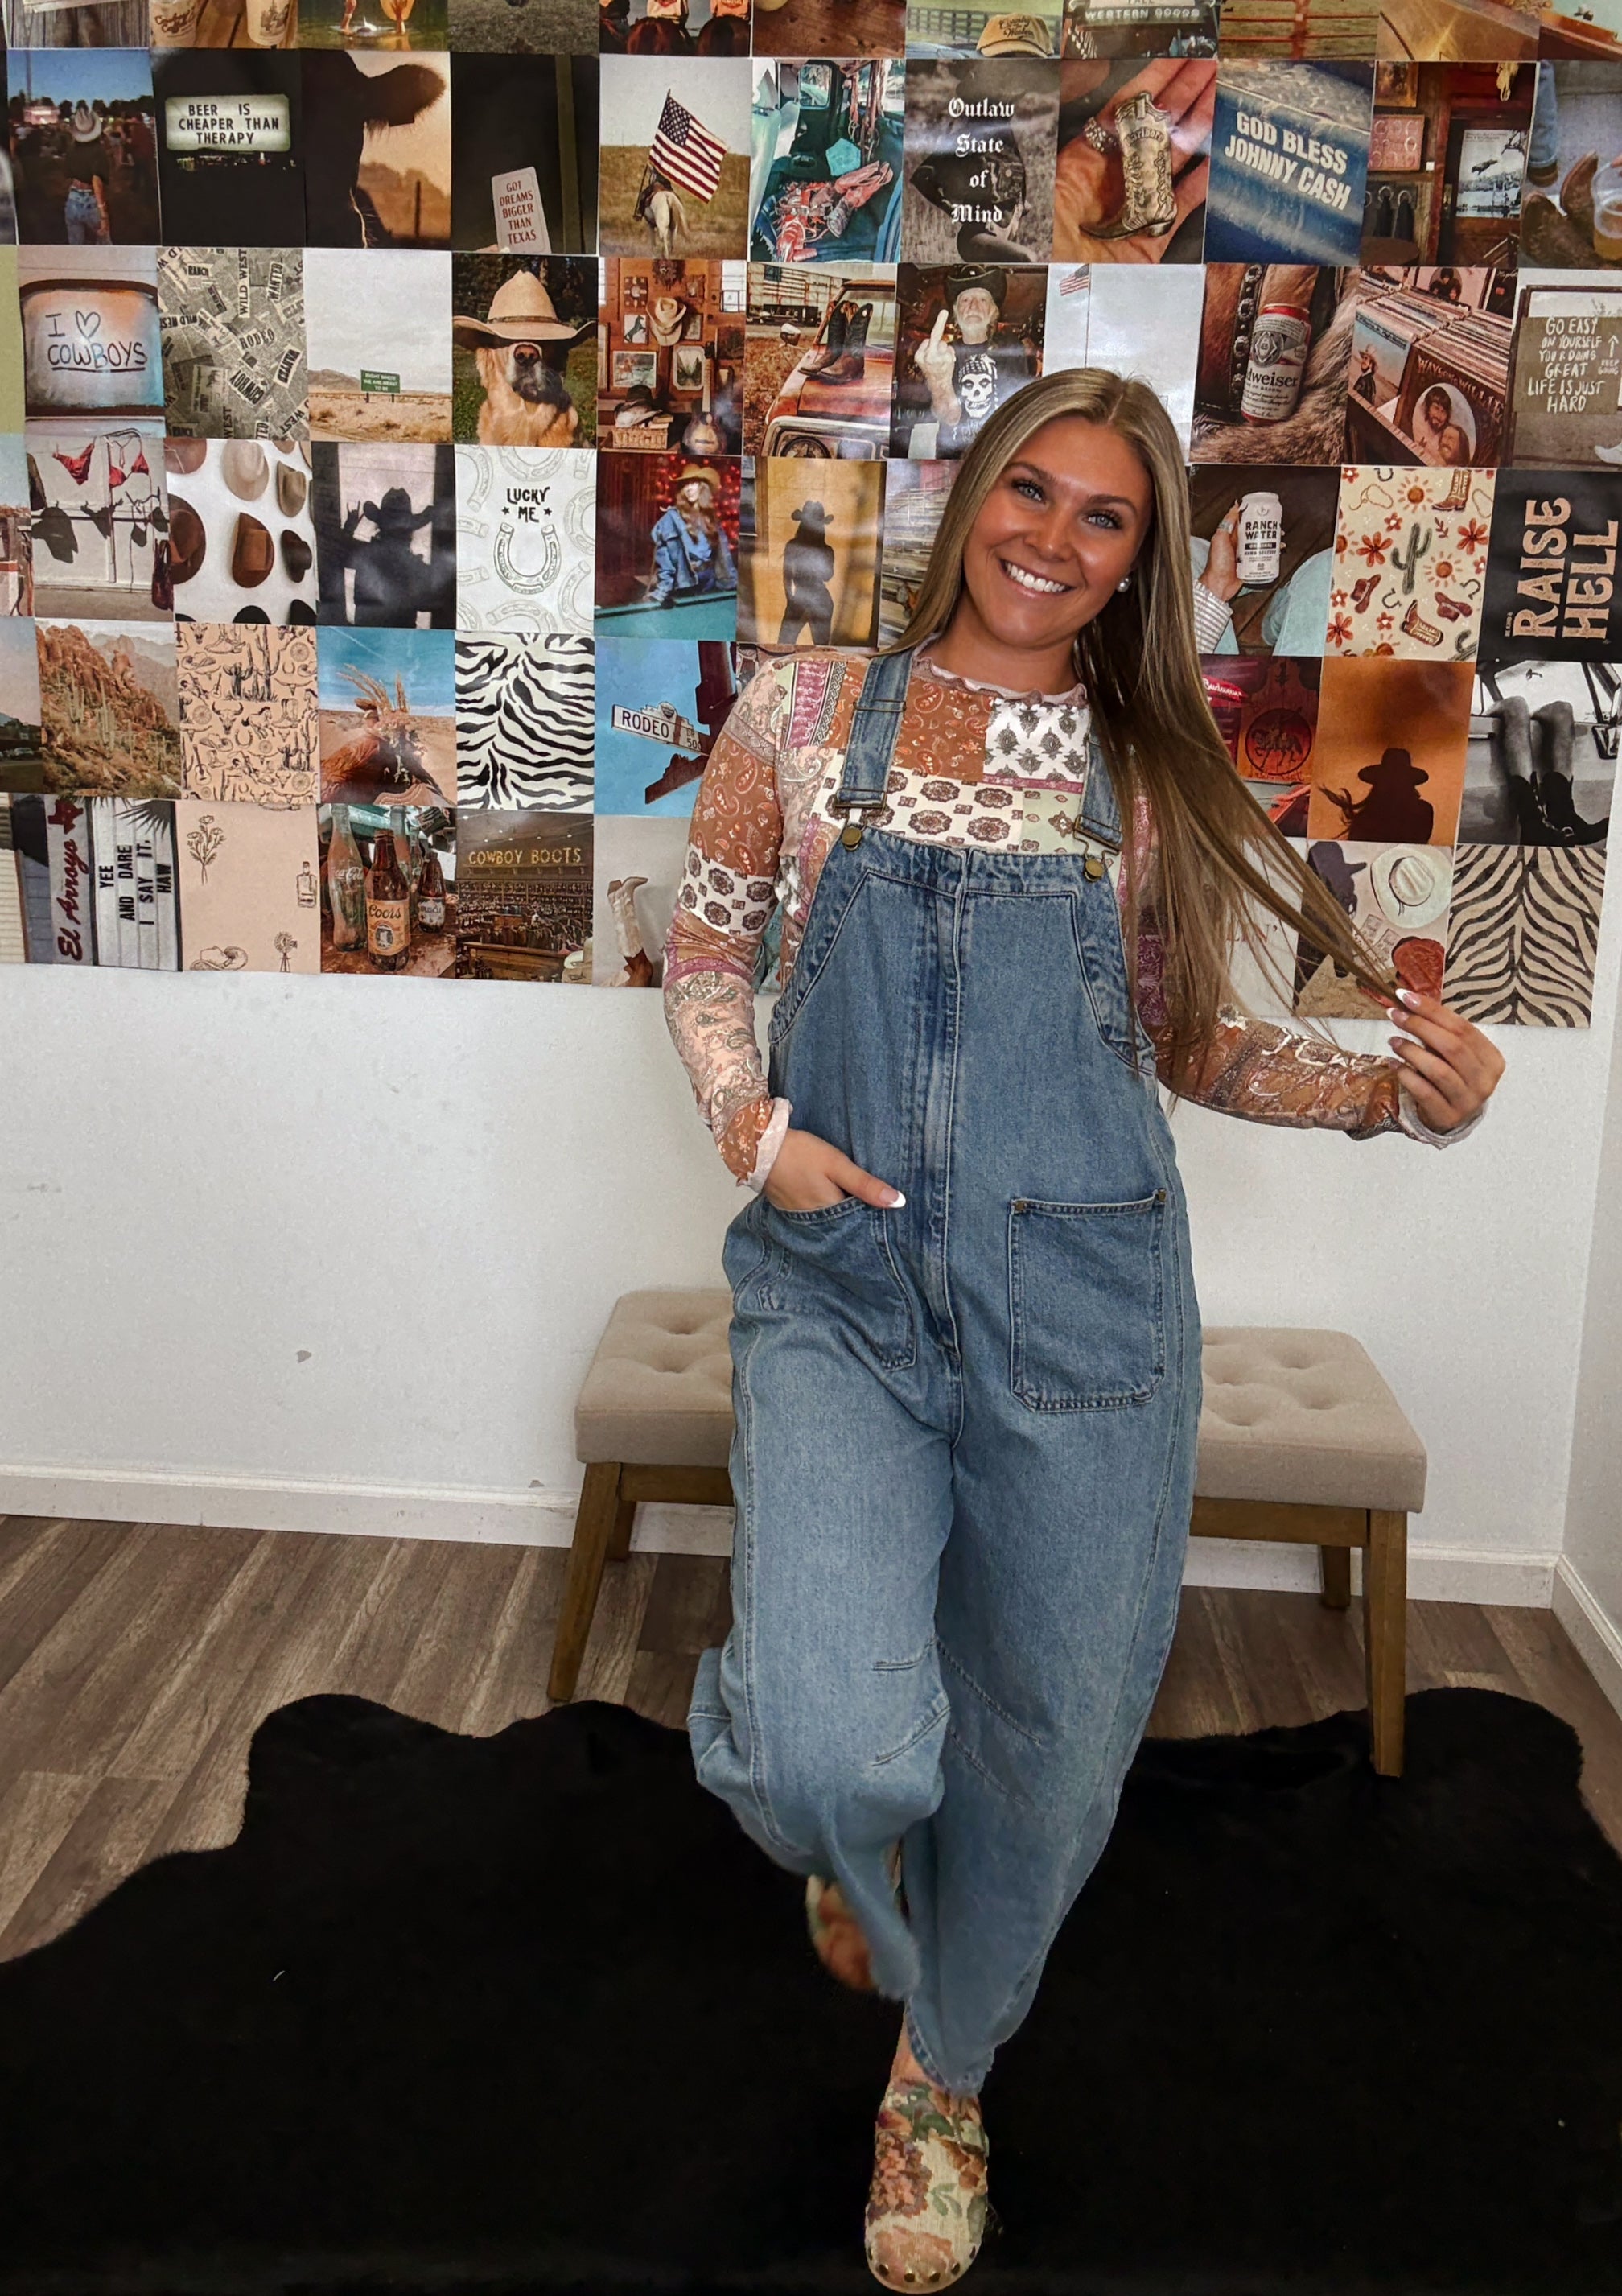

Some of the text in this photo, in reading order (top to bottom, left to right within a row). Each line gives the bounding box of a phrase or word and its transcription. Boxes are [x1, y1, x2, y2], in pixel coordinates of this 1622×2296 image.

[1085, 8, 1200, 20] WESTERN GOODS
[188, 103, 250, 116] BEER IS
[948, 97, 1015, 117] Outlaw
[179, 117, 279, 130] CHEAPER THAN
[197, 131, 254, 145] THERAPY
[955, 132, 1005, 158] State
[1237, 111, 1348, 175] GOD BLESS
[969, 169, 990, 188] of
[1225, 134, 1352, 211] JOHNNY CASH
[506, 180, 521, 192] GOT
[500, 190, 533, 207] DREAMS
[502, 203, 534, 219] BIGGER
[951, 203, 1003, 225] Mind
[508, 216, 532, 230] THAN
[507, 229, 537, 245] TEXAS
[237, 249, 248, 315] WILD WEST
[45, 312, 66, 337] I
[1546, 317, 1599, 336] GO EASY
[239, 328, 276, 350] RODEO
[1541, 334, 1603, 349] ON YOURSELF
[47, 340, 148, 369] COWBOYS
[1538, 349, 1557, 362] YOU
[1568, 350, 1596, 361] DOING
[1246, 368, 1299, 388] dweiser
[1544, 362, 1588, 379] GREAT
[229, 369, 265, 405] COWBOY
[1527, 377, 1606, 396] LIFE IS JUST
[1546, 394, 1587, 414] HARD
[279, 409, 305, 435] WEST
[507, 486, 550, 505] LUCKY
[518, 506, 539, 523] ME
[1245, 521, 1278, 531] RANCH
[1245, 530, 1277, 540] WATER
[1513, 497, 1571, 638] RAISE
[1562, 520, 1619, 639] HELL
[622, 710, 669, 739] RODEO
[136, 839, 153, 859] IT,
[468, 847, 582, 865] COWBOY BOOTS
[98, 865, 114, 889] YEE
[117, 844, 135, 921] AND DARE
[156, 863, 171, 894] HAW
[138, 876, 154, 903] SAY
[56, 838, 90, 962] El Arroyo
[368, 904, 401, 919] Coors
